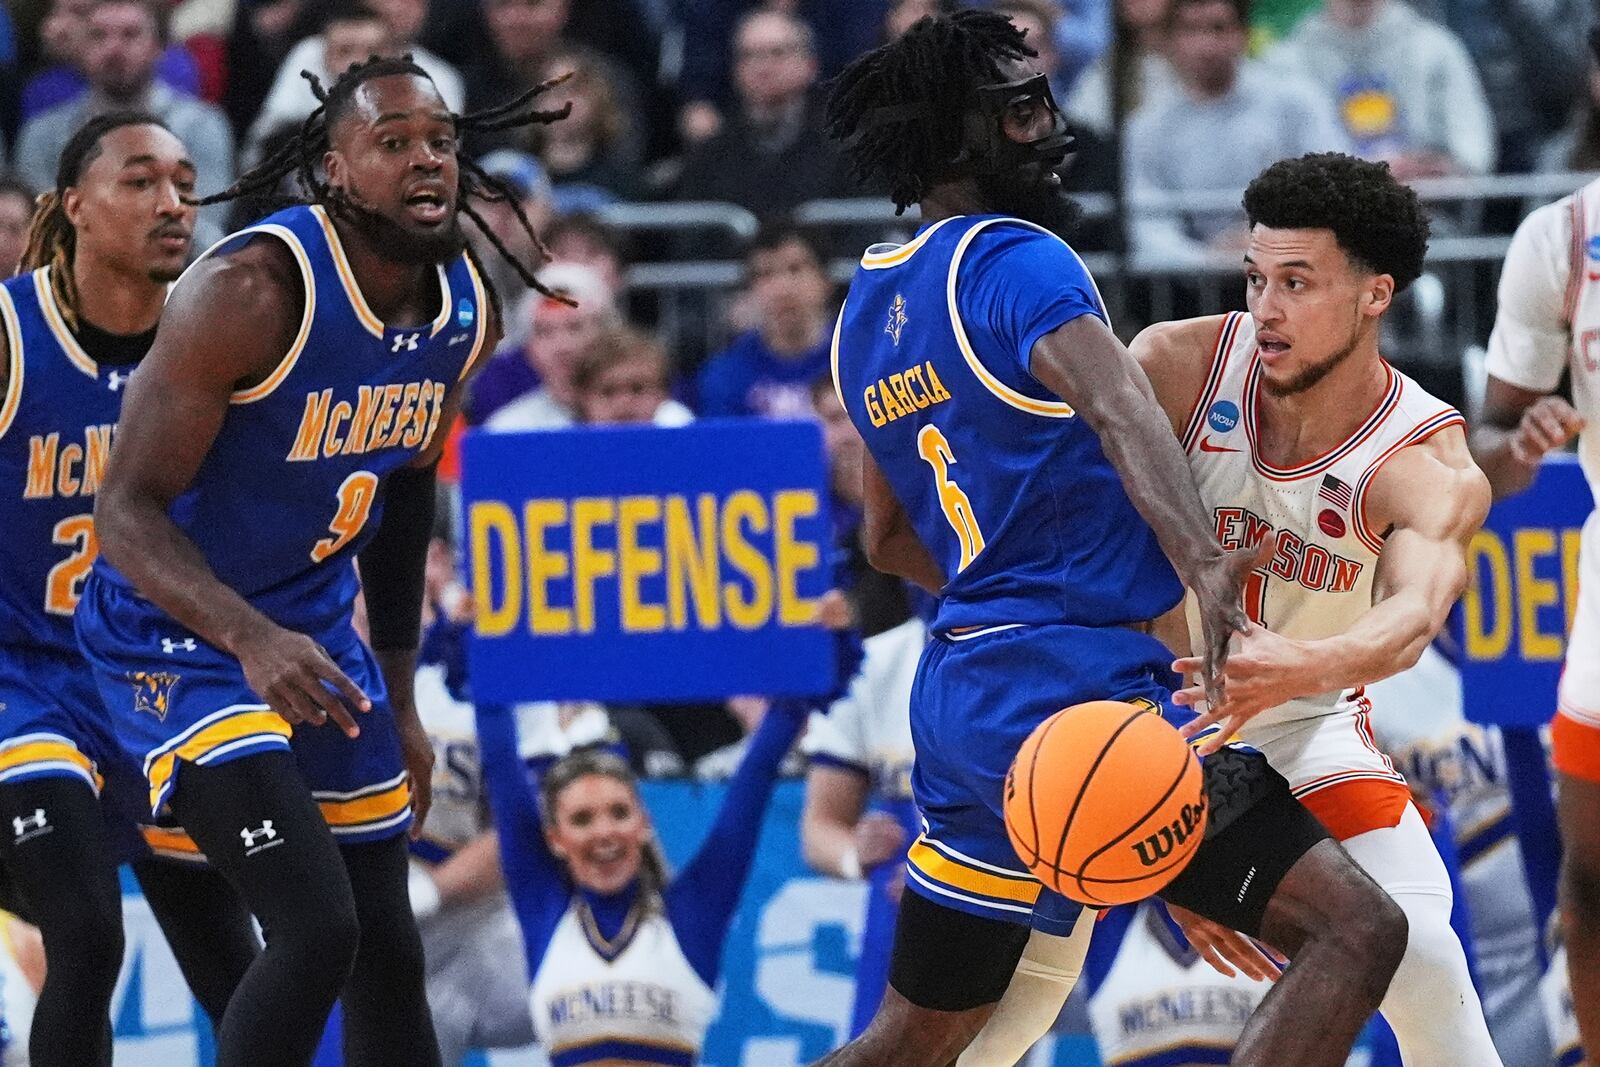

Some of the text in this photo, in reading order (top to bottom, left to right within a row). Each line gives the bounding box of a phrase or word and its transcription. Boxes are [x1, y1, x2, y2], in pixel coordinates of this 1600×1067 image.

[863, 360, 951, 428] GARCIA
[1210, 412, 1235, 428] NCAA
[23, 423, 118, 500] McN
[917, 423, 985, 574] 6
[310, 470, 380, 563] 9
[44, 512, 98, 617] 2
[469, 488, 820, 637] DEFENSE
[1131, 803, 1204, 866] Wils
